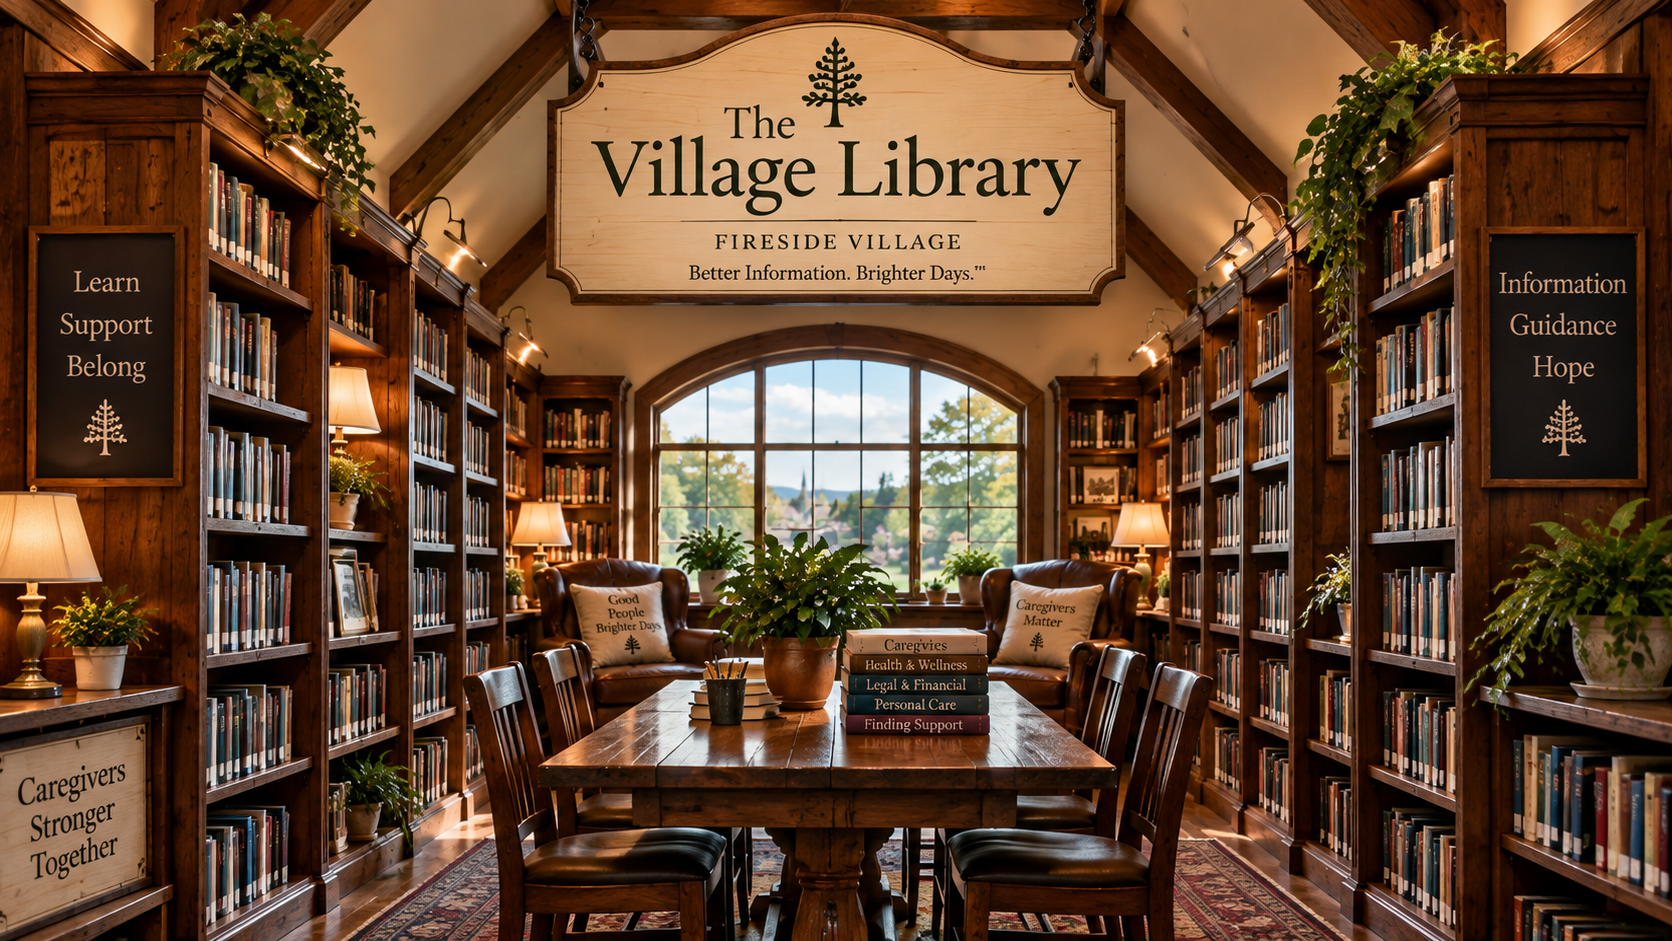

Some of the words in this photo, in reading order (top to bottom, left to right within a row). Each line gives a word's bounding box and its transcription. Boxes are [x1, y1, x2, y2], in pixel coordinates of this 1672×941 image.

[724, 105, 795, 139] The
[591, 135, 815, 216] Village
[838, 135, 1081, 216] Library
[716, 234, 836, 249] FIRESIDE
[848, 234, 960, 249] VILLAGE
[74, 271, 140, 292] Learn
[689, 265, 739, 281] Better
[745, 264, 850, 280] Information.
[856, 265, 925, 285] Brighter
[1499, 271, 1627, 293] Information
[60, 312, 153, 341] Support
[1510, 313, 1616, 335] Guidance
[67, 354, 146, 383] Belong
[1533, 356, 1594, 384] Hope
[608, 594, 640, 605] Good
[1016, 599, 1076, 614] Caregivers
[607, 606, 645, 620] People
[1023, 615, 1063, 627] Matter
[596, 622, 636, 635] Brighter
[639, 621, 661, 633] Days
[866, 659, 902, 670] Health
[906, 660, 914, 670] &
[919, 659, 967, 670] Wellness
[867, 678, 897, 693] Legal
[901, 679, 909, 690] &
[915, 678, 965, 690] Financial
[875, 699, 925, 710] Personal
[929, 699, 956, 710] Care
[865, 718, 910, 733] Finding
[915, 719, 962, 733] Support
[18, 763, 126, 805] Caregivers
[30, 803, 115, 842] Stronger
[30, 837, 118, 880] Together
